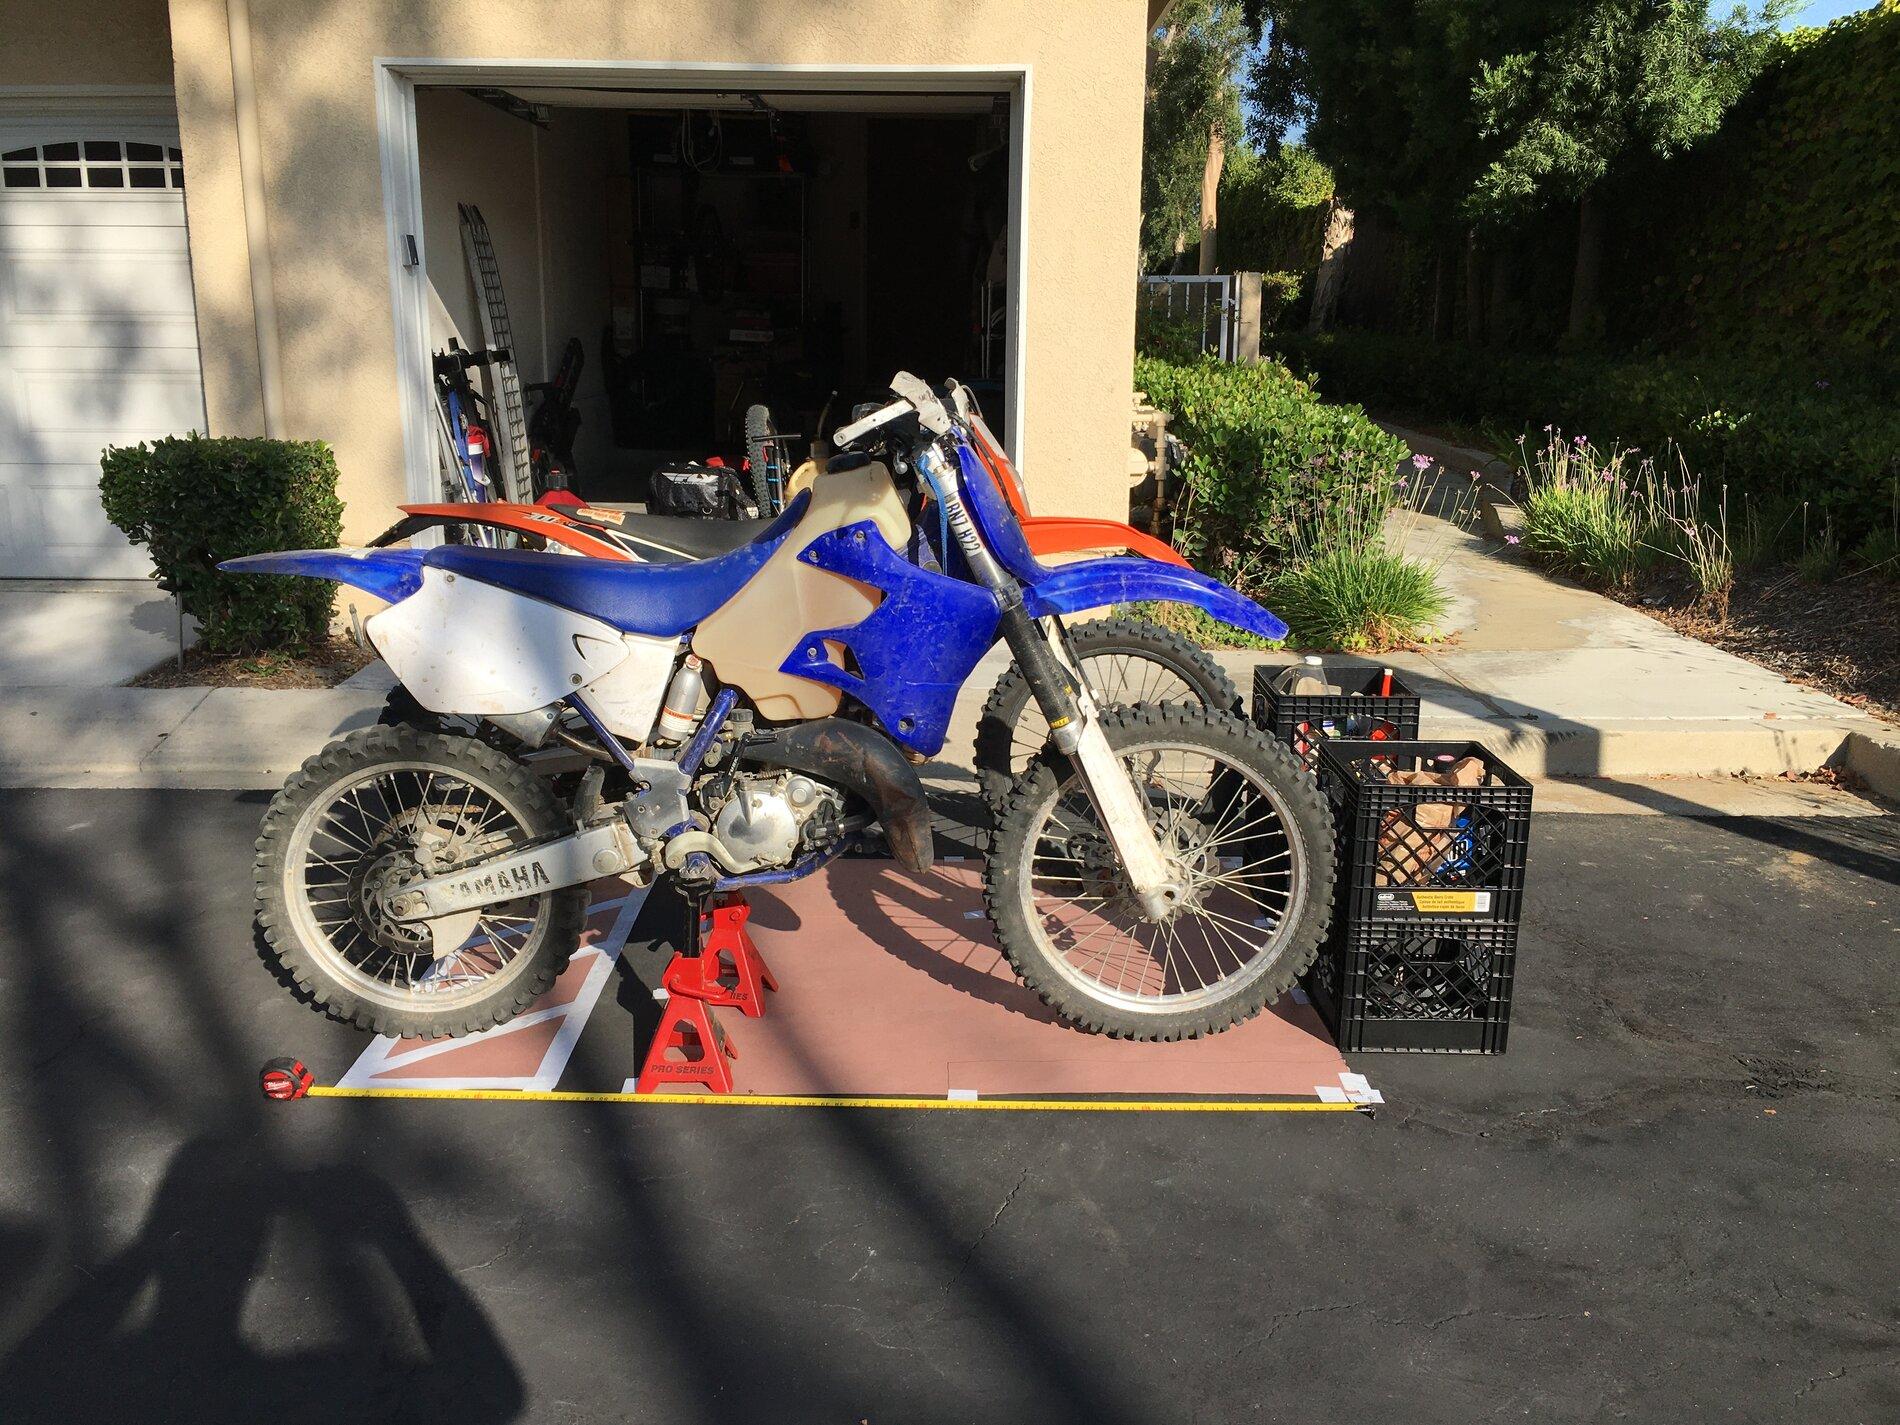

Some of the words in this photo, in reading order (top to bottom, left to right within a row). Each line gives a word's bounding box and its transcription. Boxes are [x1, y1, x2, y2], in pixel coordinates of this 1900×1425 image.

[959, 528, 980, 552] H22
[449, 861, 550, 897] AMAHA
[650, 1064, 673, 1074] PRO
[675, 1065, 714, 1075] SERIES
